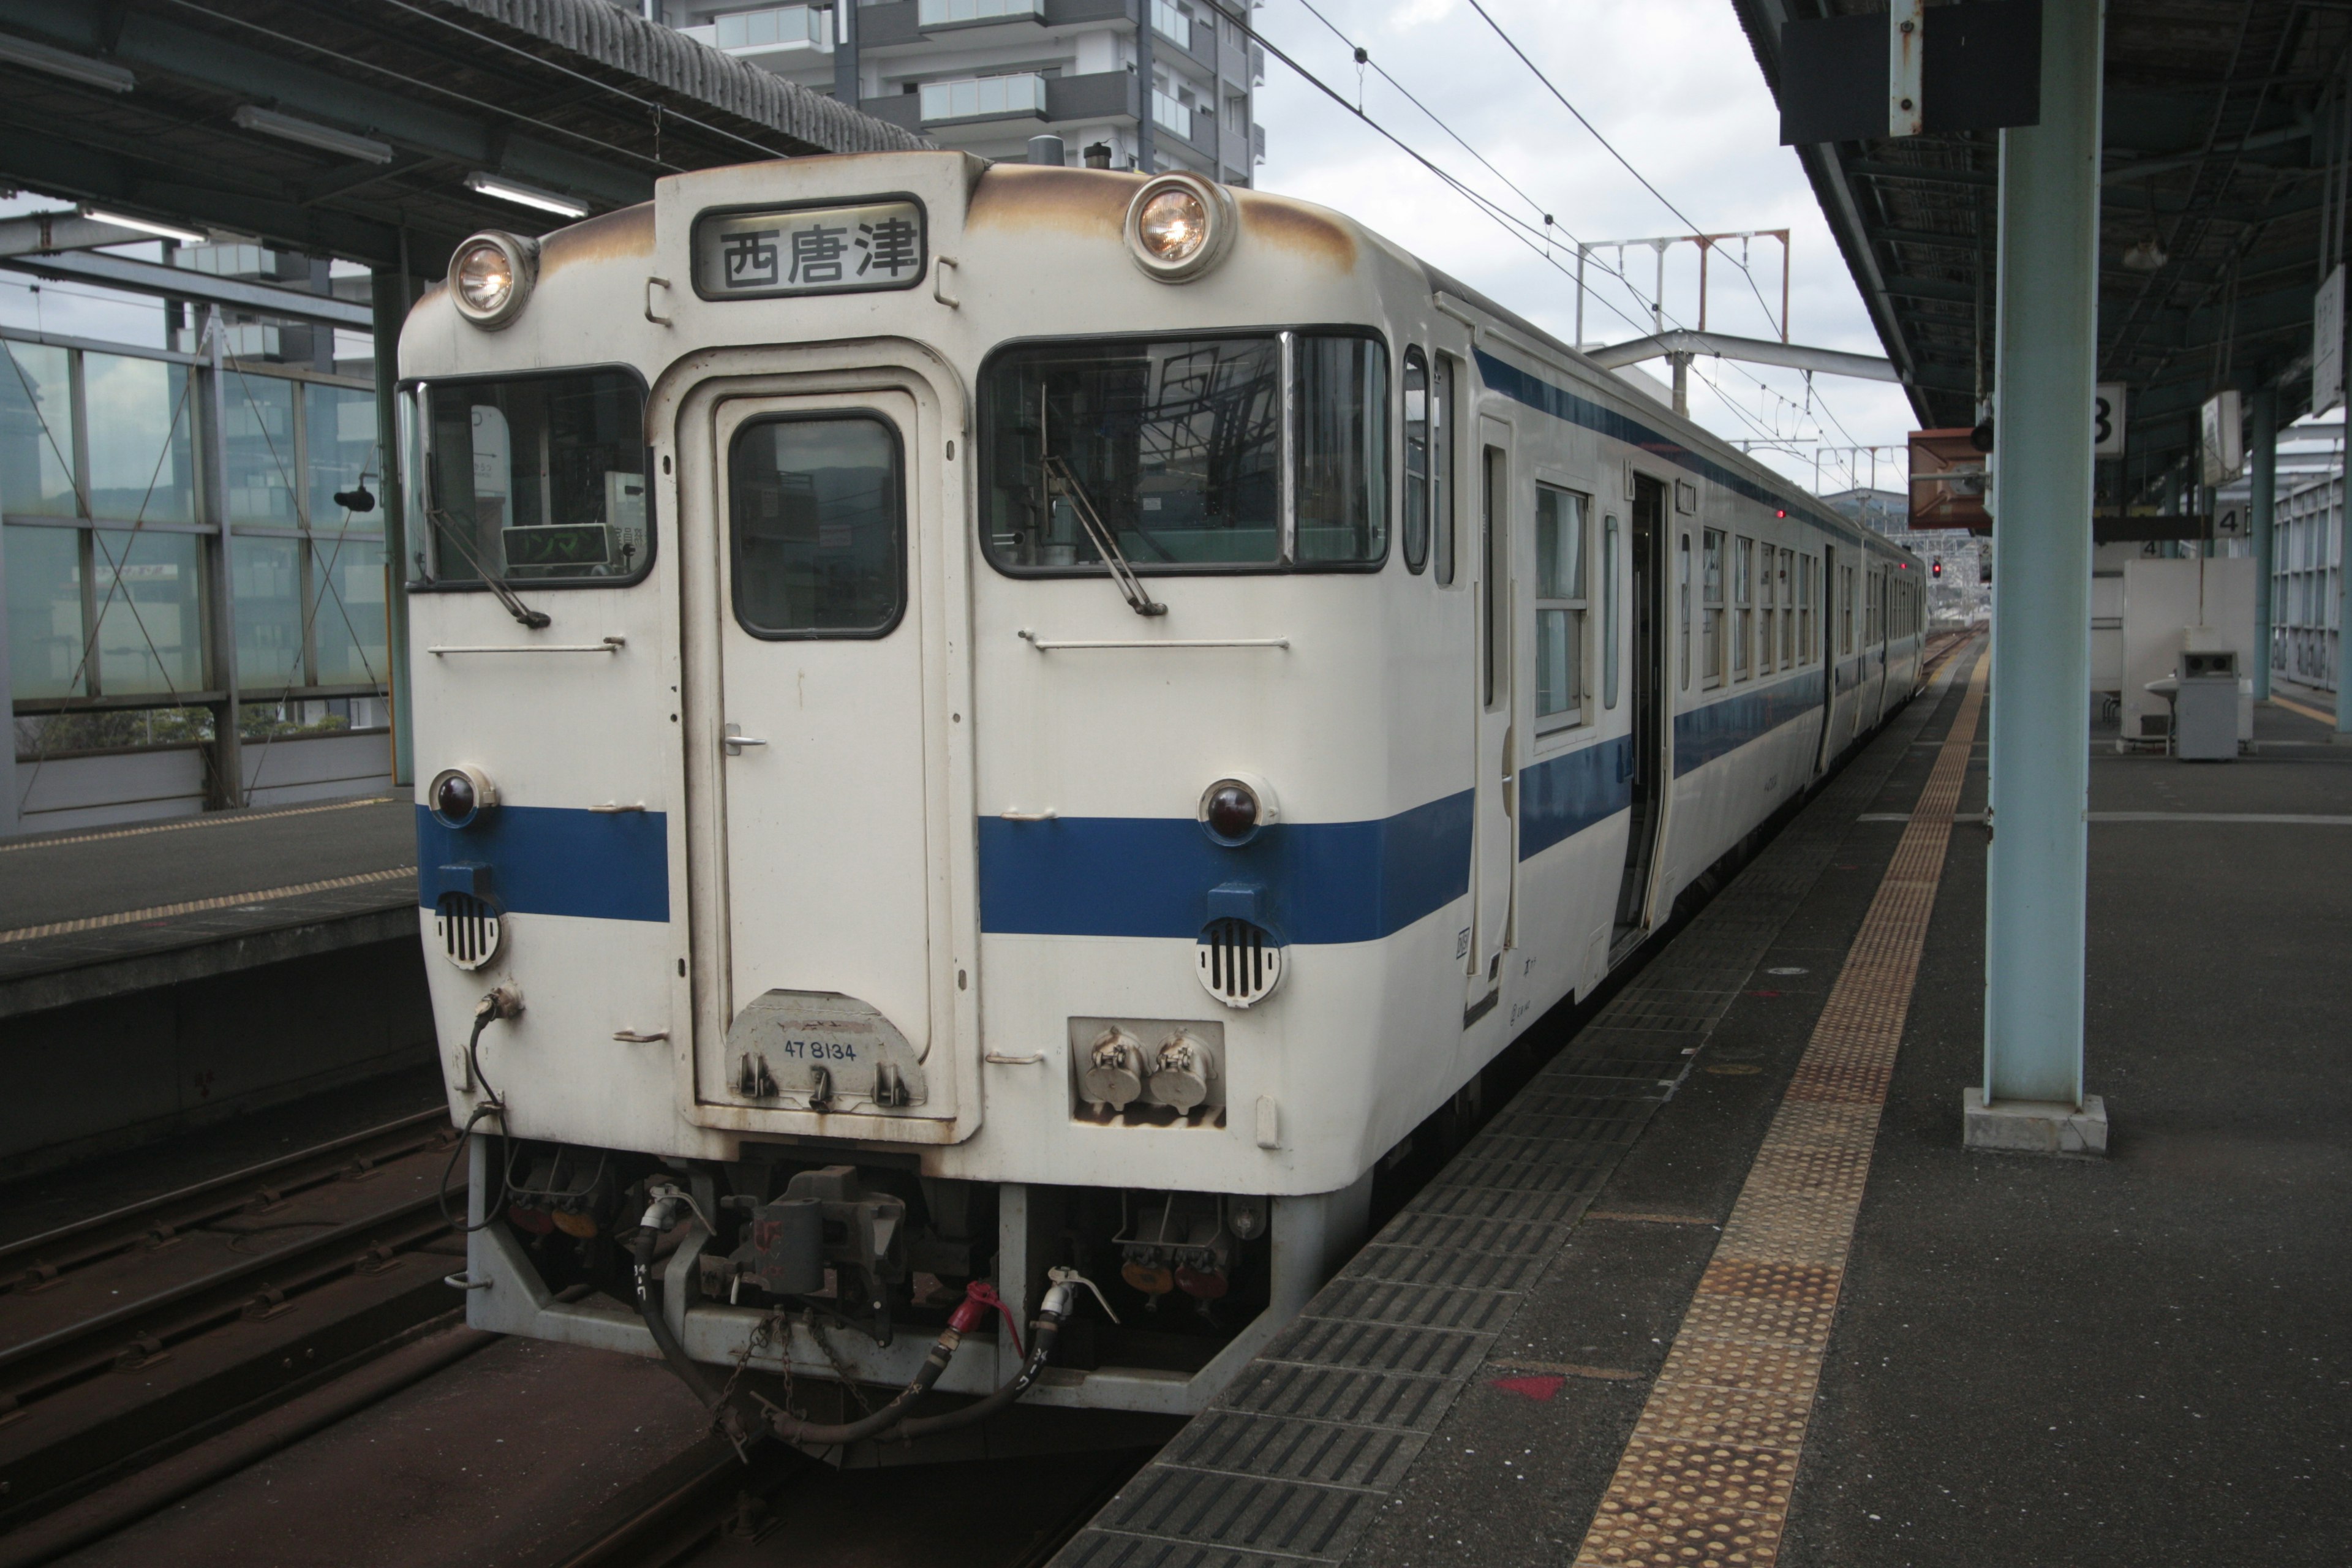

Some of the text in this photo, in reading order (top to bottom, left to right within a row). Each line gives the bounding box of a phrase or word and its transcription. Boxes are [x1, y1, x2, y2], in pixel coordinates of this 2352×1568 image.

[720, 217, 918, 288] 西唐津
[2218, 510, 2240, 533] 4
[2143, 541, 2157, 555] 4
[785, 1041, 857, 1061] 47 8134
